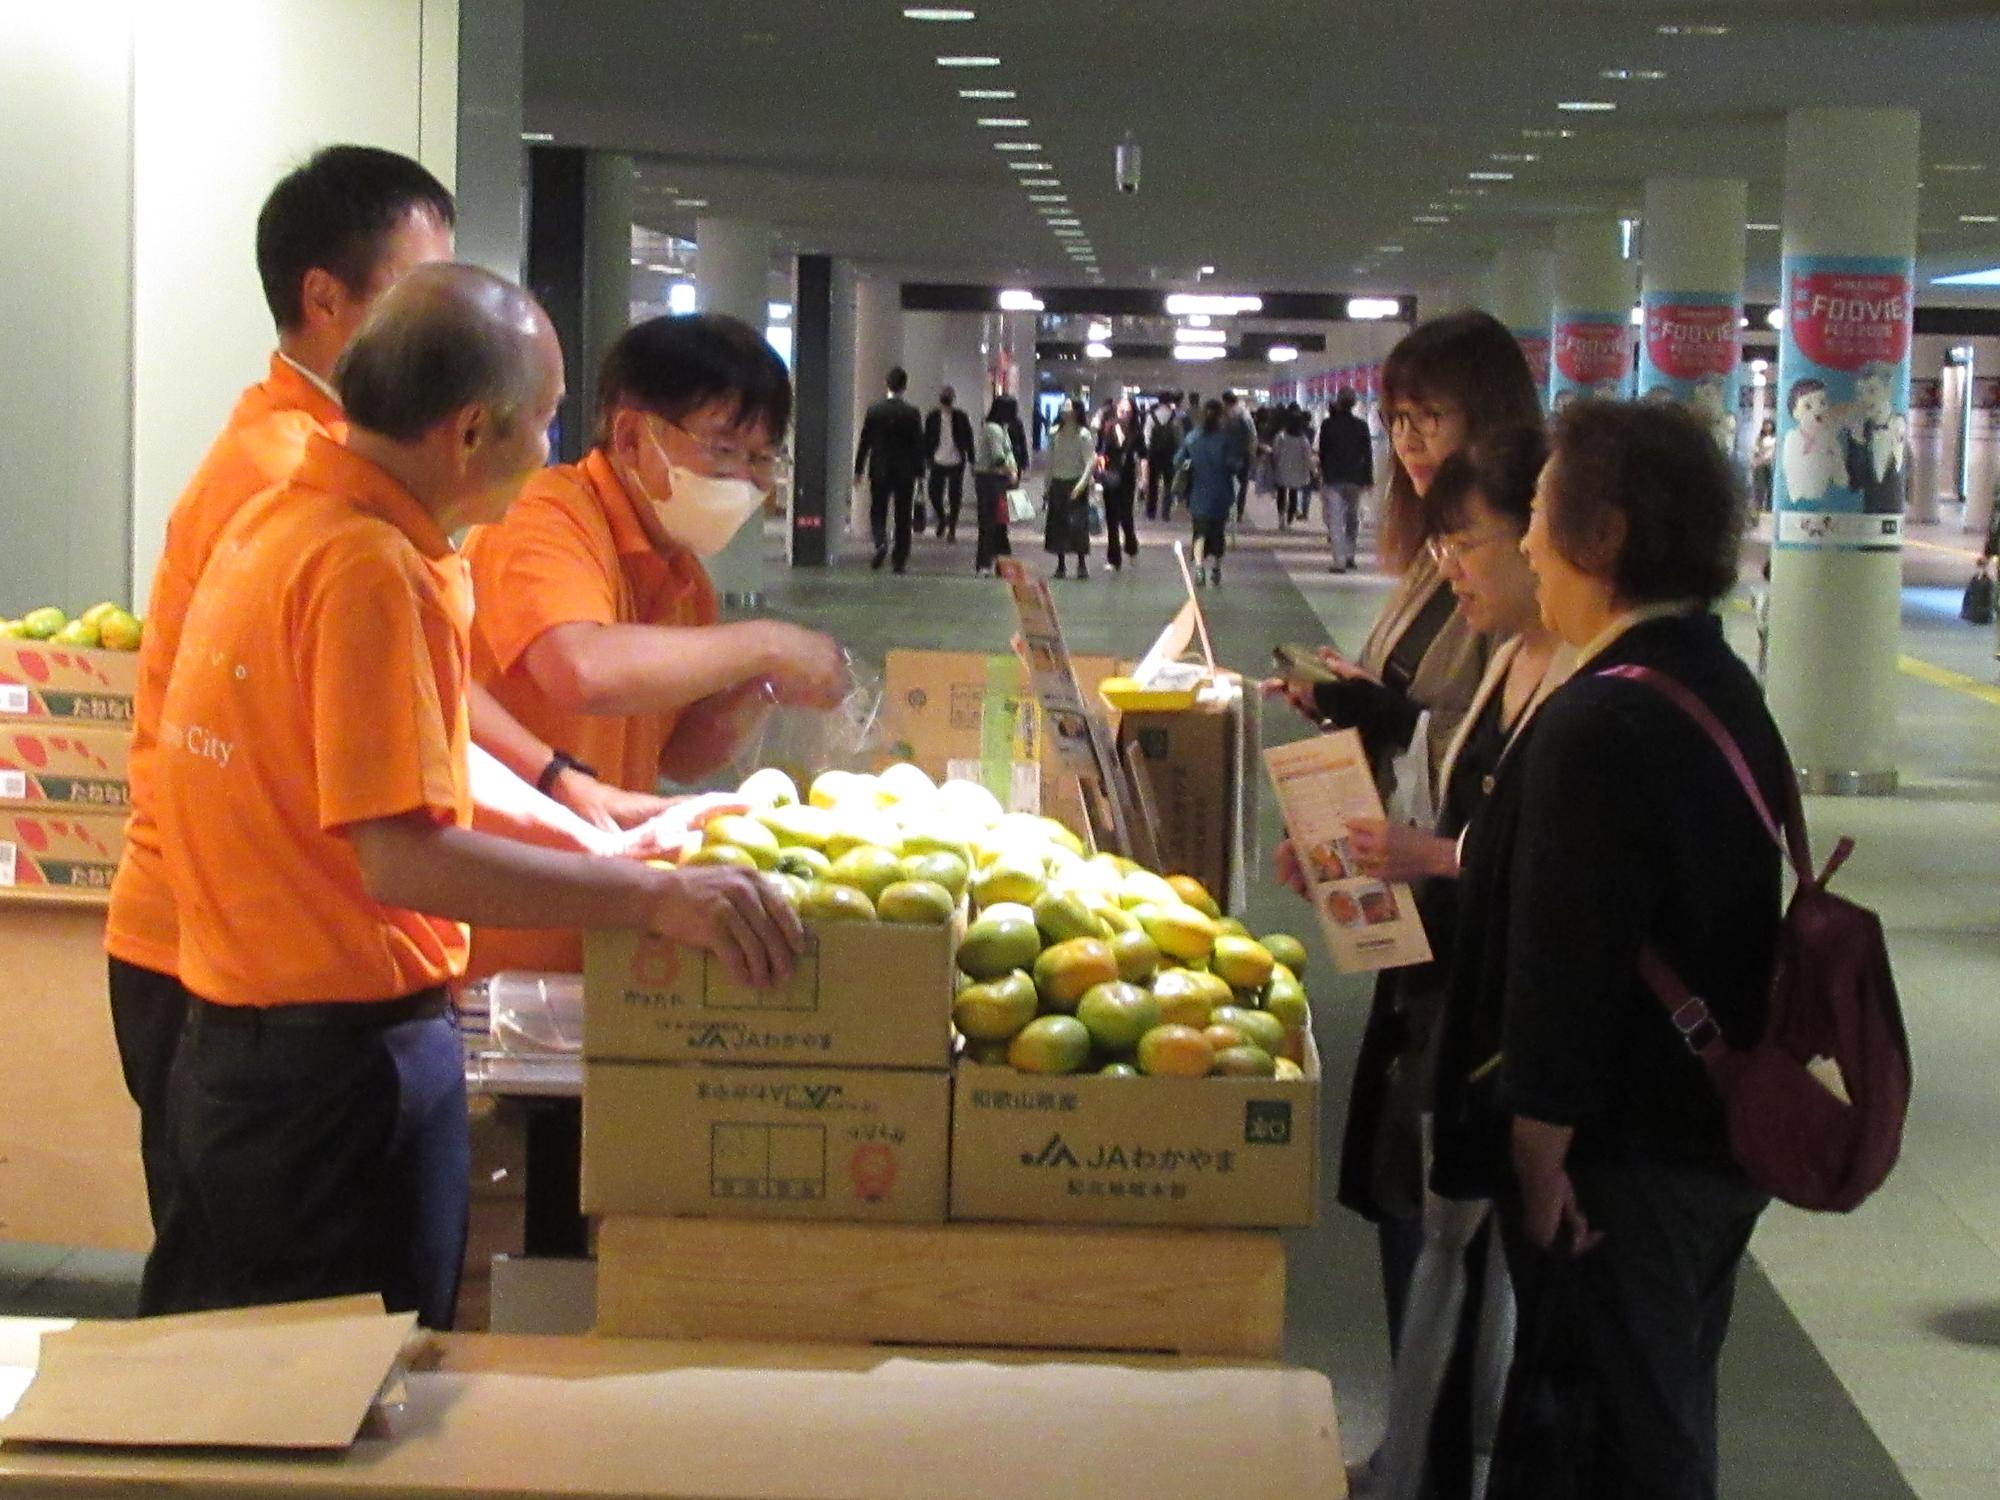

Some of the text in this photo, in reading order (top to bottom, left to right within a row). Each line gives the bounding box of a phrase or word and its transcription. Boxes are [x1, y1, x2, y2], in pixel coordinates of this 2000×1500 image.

[188, 726, 233, 768] City
[1086, 1144, 1236, 1174] JAわかやま
